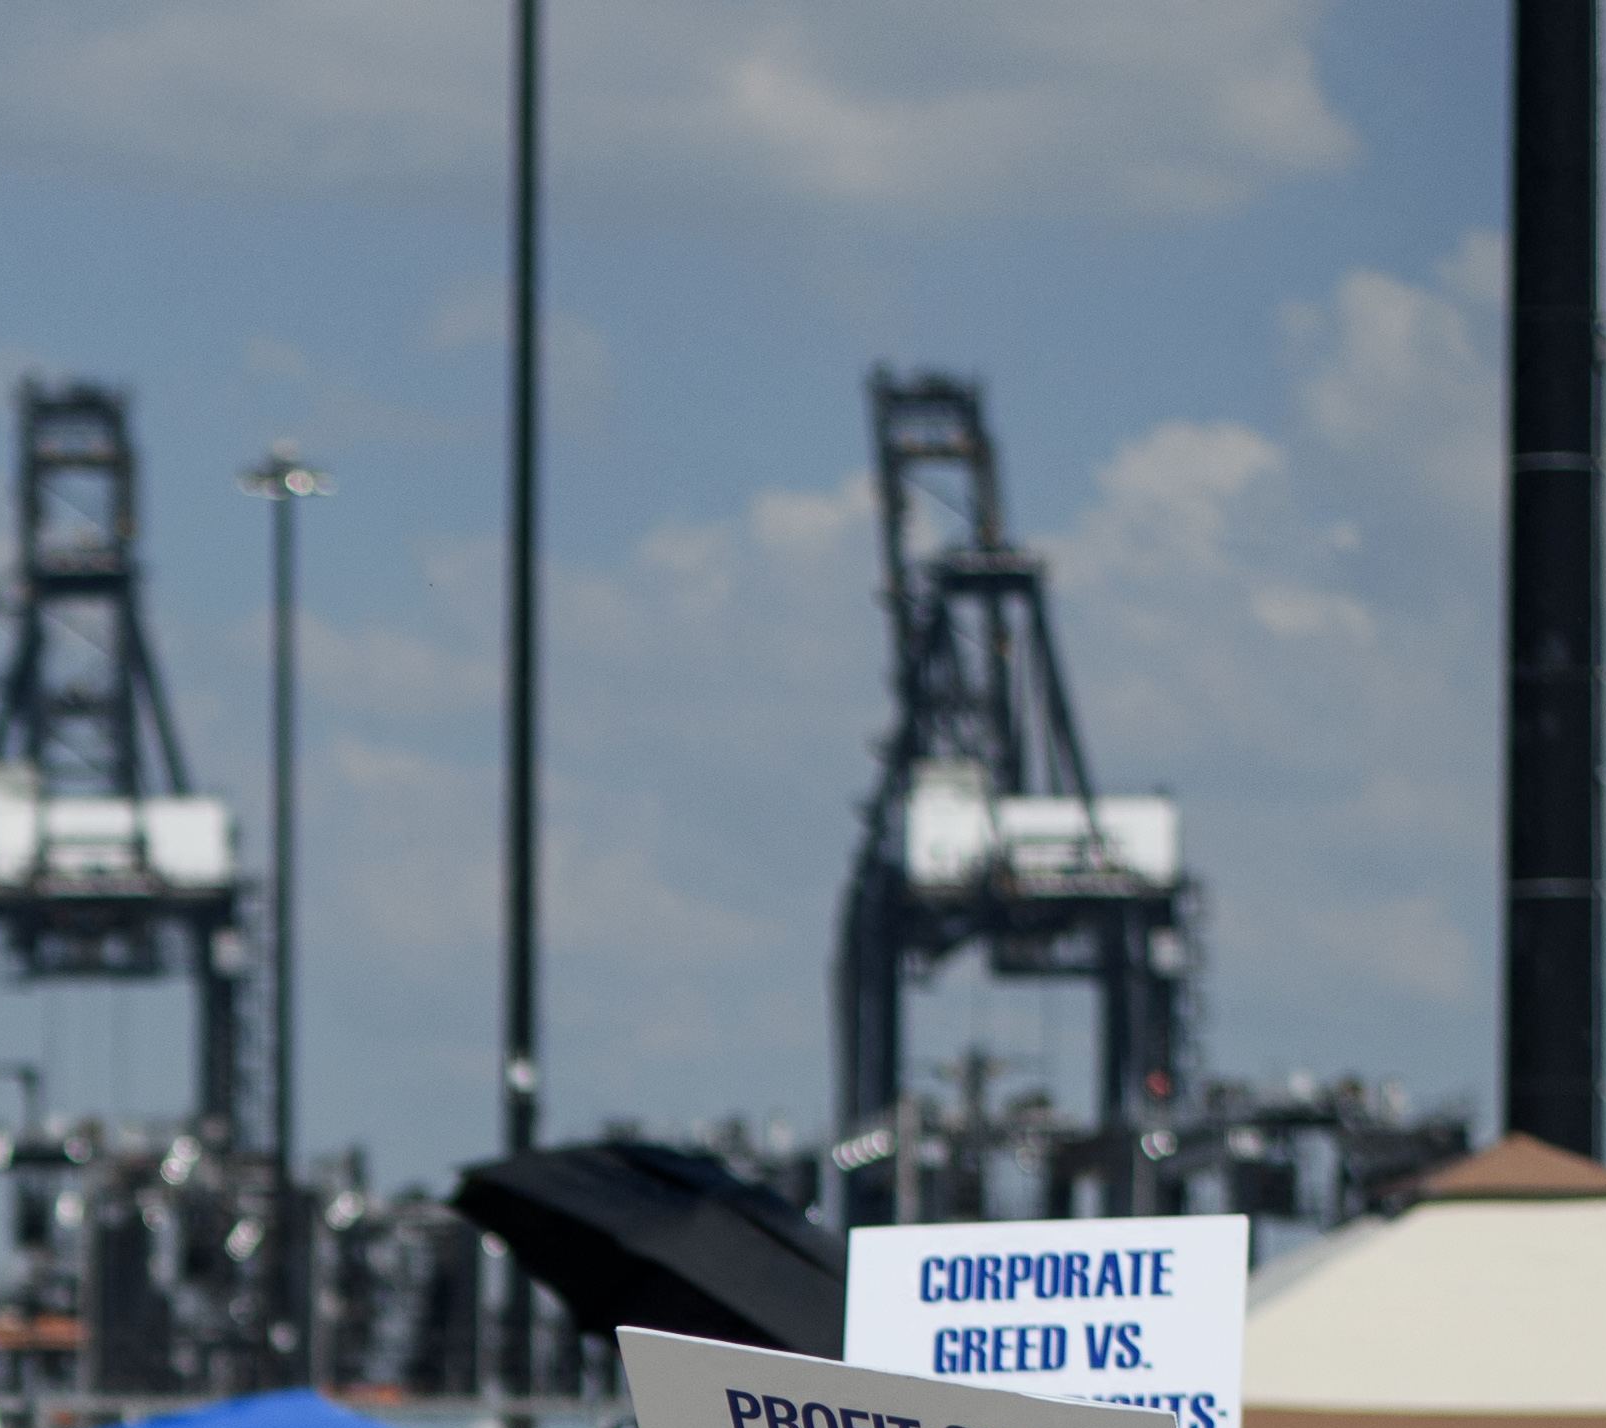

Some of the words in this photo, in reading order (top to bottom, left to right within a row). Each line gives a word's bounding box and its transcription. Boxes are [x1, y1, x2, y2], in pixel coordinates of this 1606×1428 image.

[920, 1248, 1175, 1304] CORPORATE
[933, 1324, 1068, 1376] GREED
[1084, 1322, 1153, 1373] VS.
